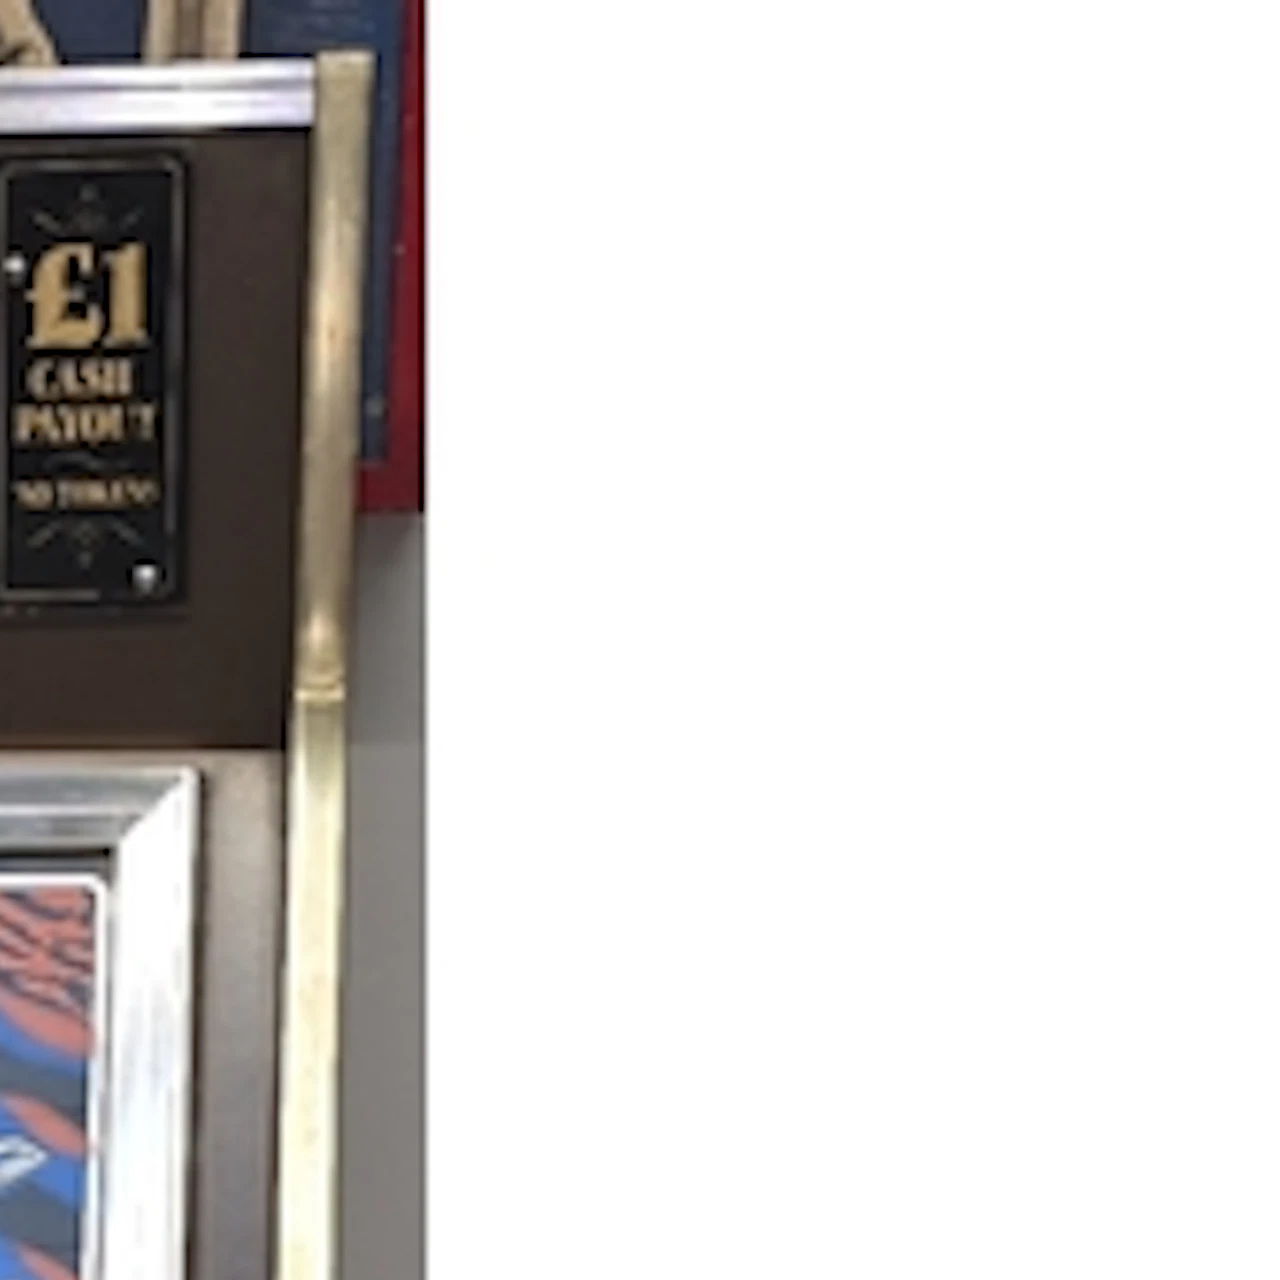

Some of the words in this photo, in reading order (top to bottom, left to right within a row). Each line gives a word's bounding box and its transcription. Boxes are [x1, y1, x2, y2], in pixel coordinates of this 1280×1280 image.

[26, 241, 149, 350] £1
[27, 356, 133, 397] CASH
[15, 403, 158, 442] PAYOUT
